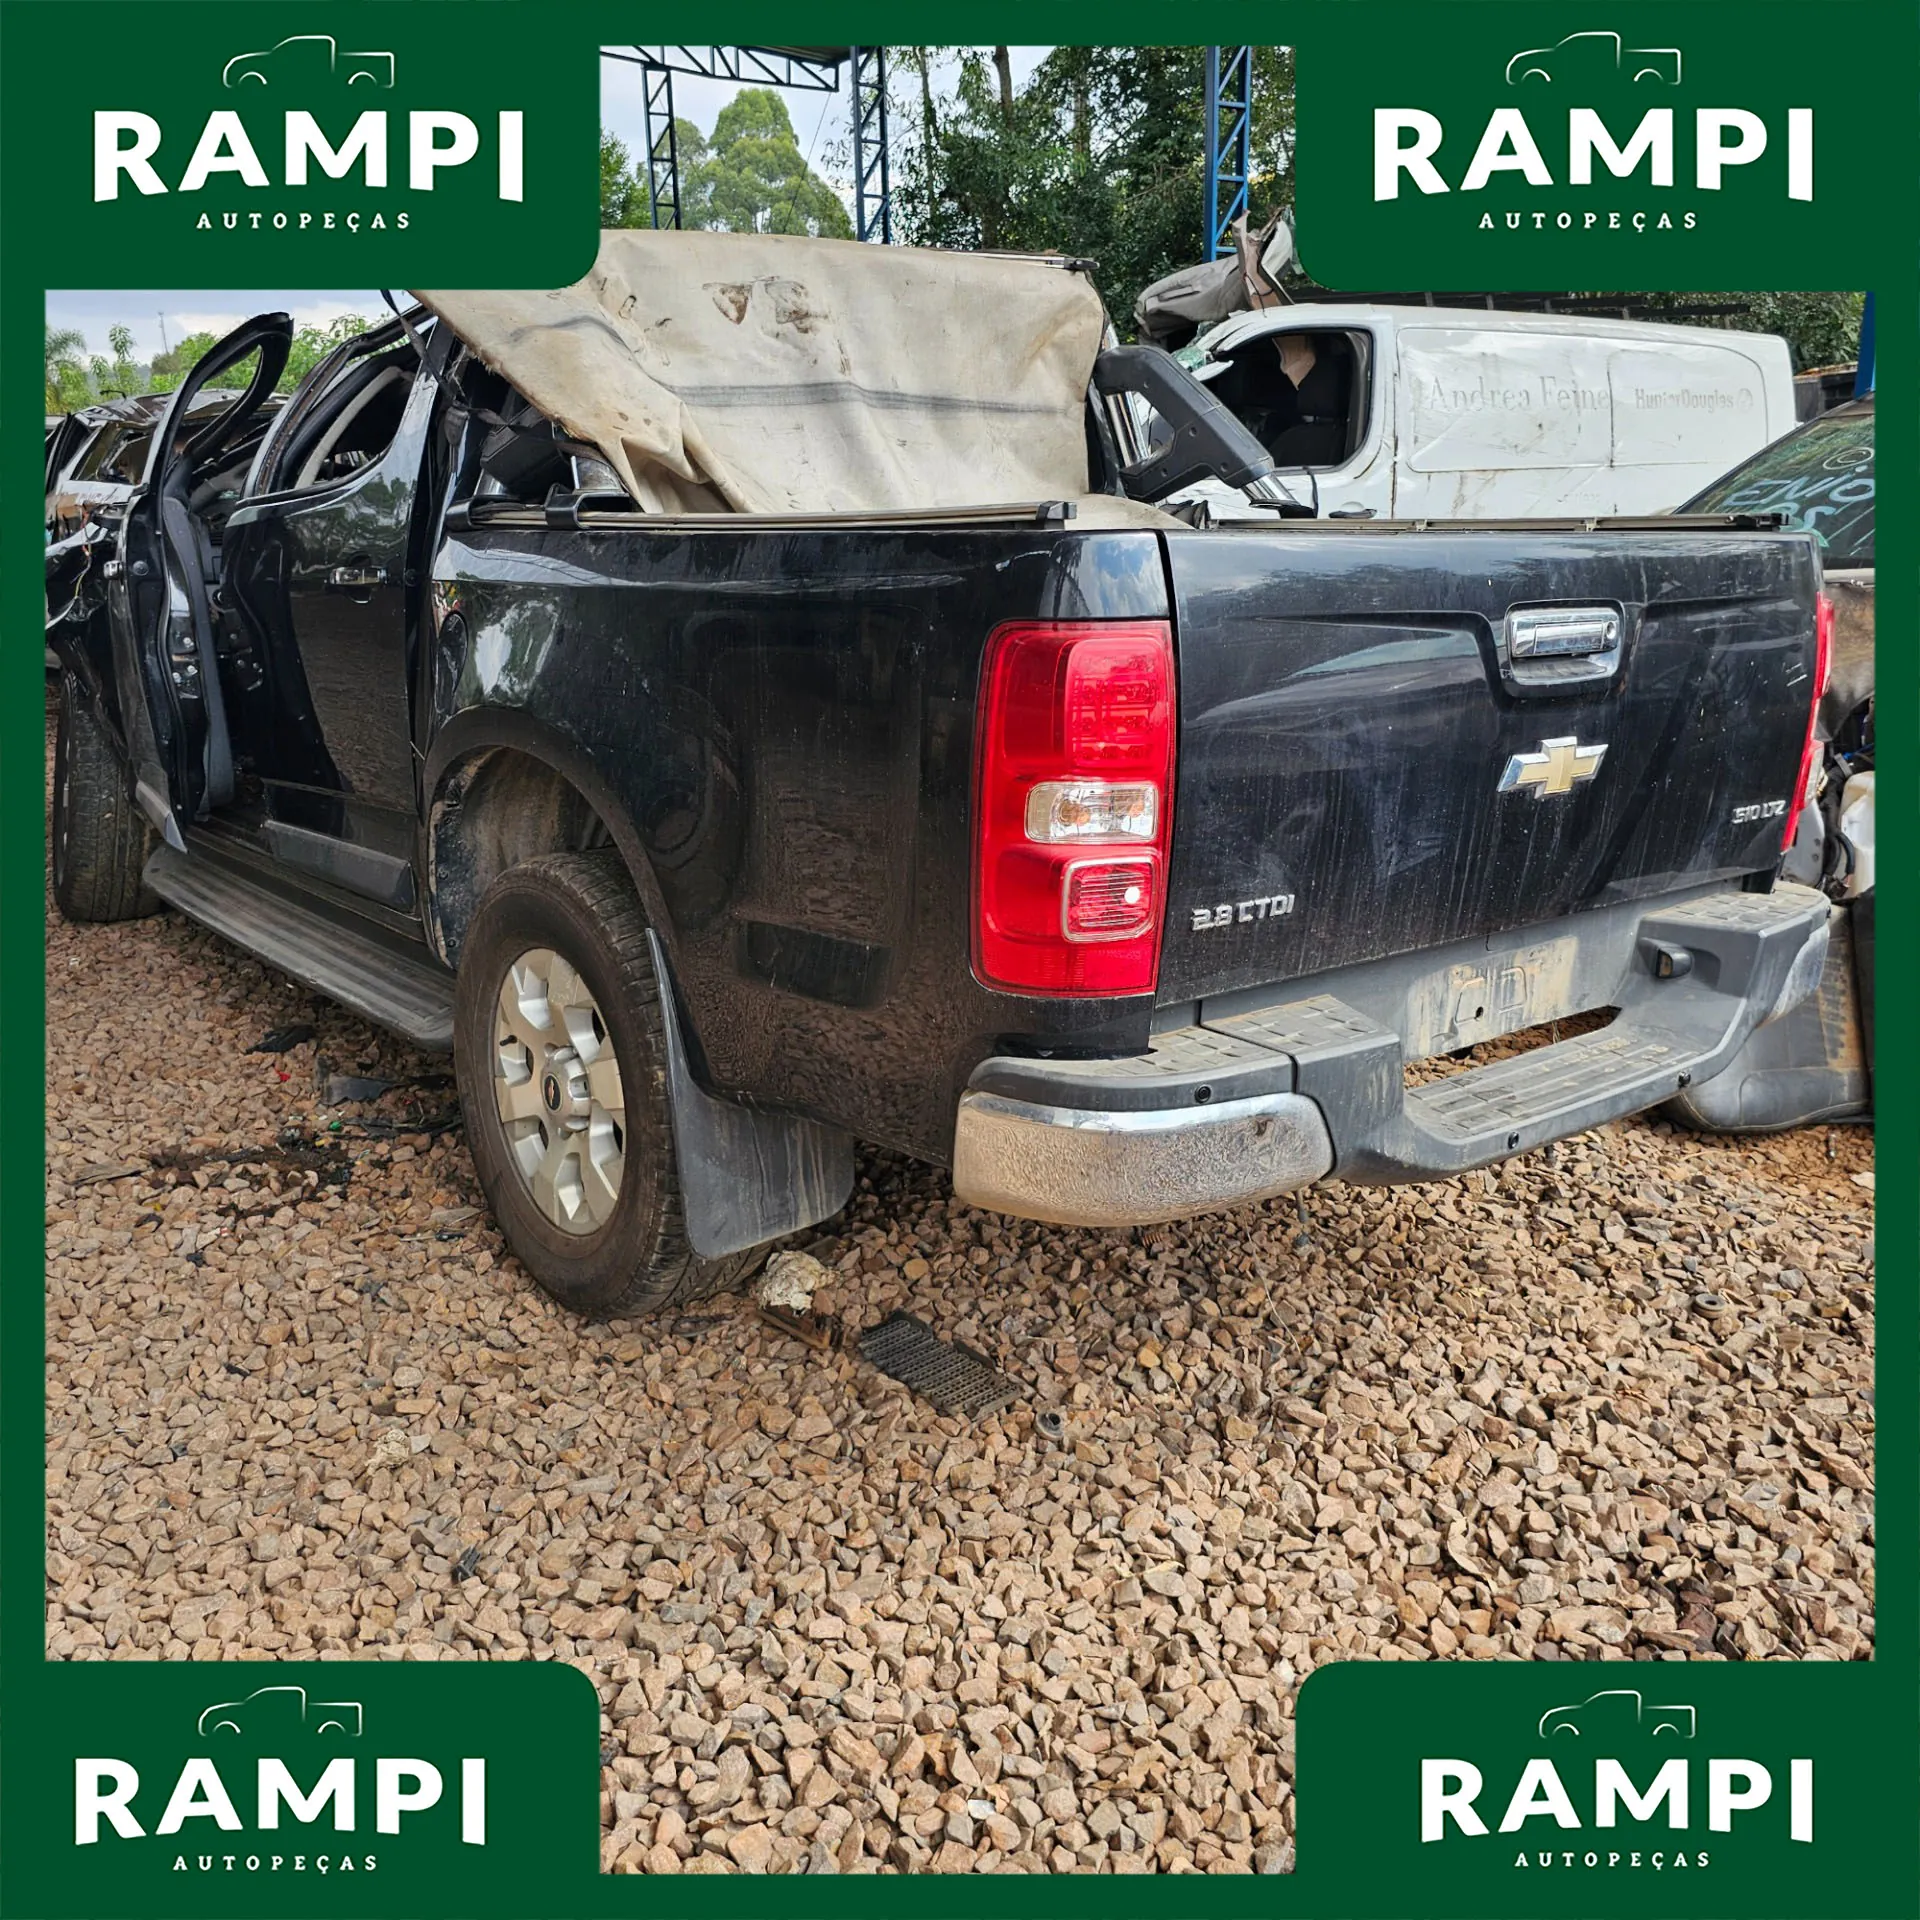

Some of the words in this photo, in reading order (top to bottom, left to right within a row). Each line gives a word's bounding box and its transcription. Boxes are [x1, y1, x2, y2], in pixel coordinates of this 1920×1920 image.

[1430, 376, 1531, 411] Andrea
[1731, 804, 1760, 824] S10
[1191, 903, 1233, 931] 2.8
[1236, 893, 1296, 923] CTDI
